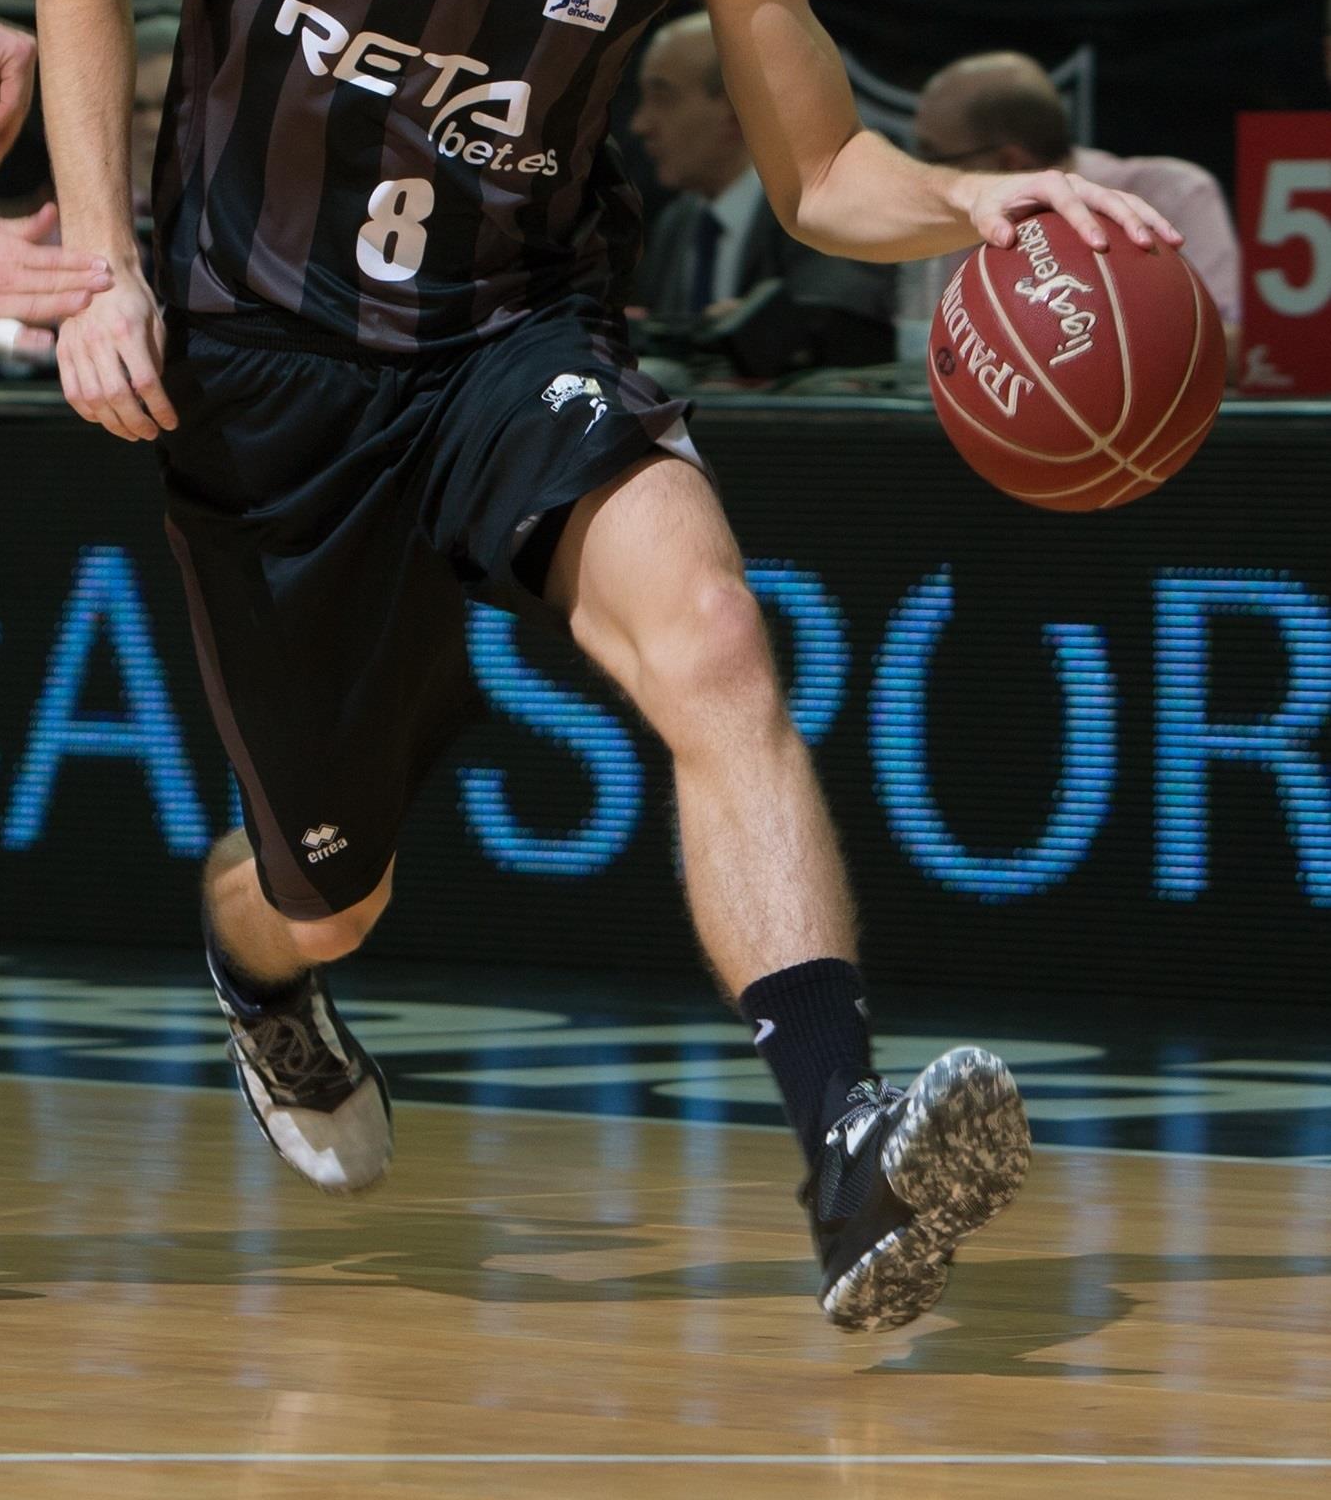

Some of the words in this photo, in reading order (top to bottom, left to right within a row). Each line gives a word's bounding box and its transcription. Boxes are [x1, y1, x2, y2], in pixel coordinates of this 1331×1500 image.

[567, 7, 606, 24] endesa
[437, 120, 558, 176] bet.es
[356, 178, 434, 282] 8
[1253, 158, 1331, 318] 5
[942, 257, 1035, 417] SPALDIN
[1048, 288, 1096, 368] liga
[307, 837, 348, 863] errea
